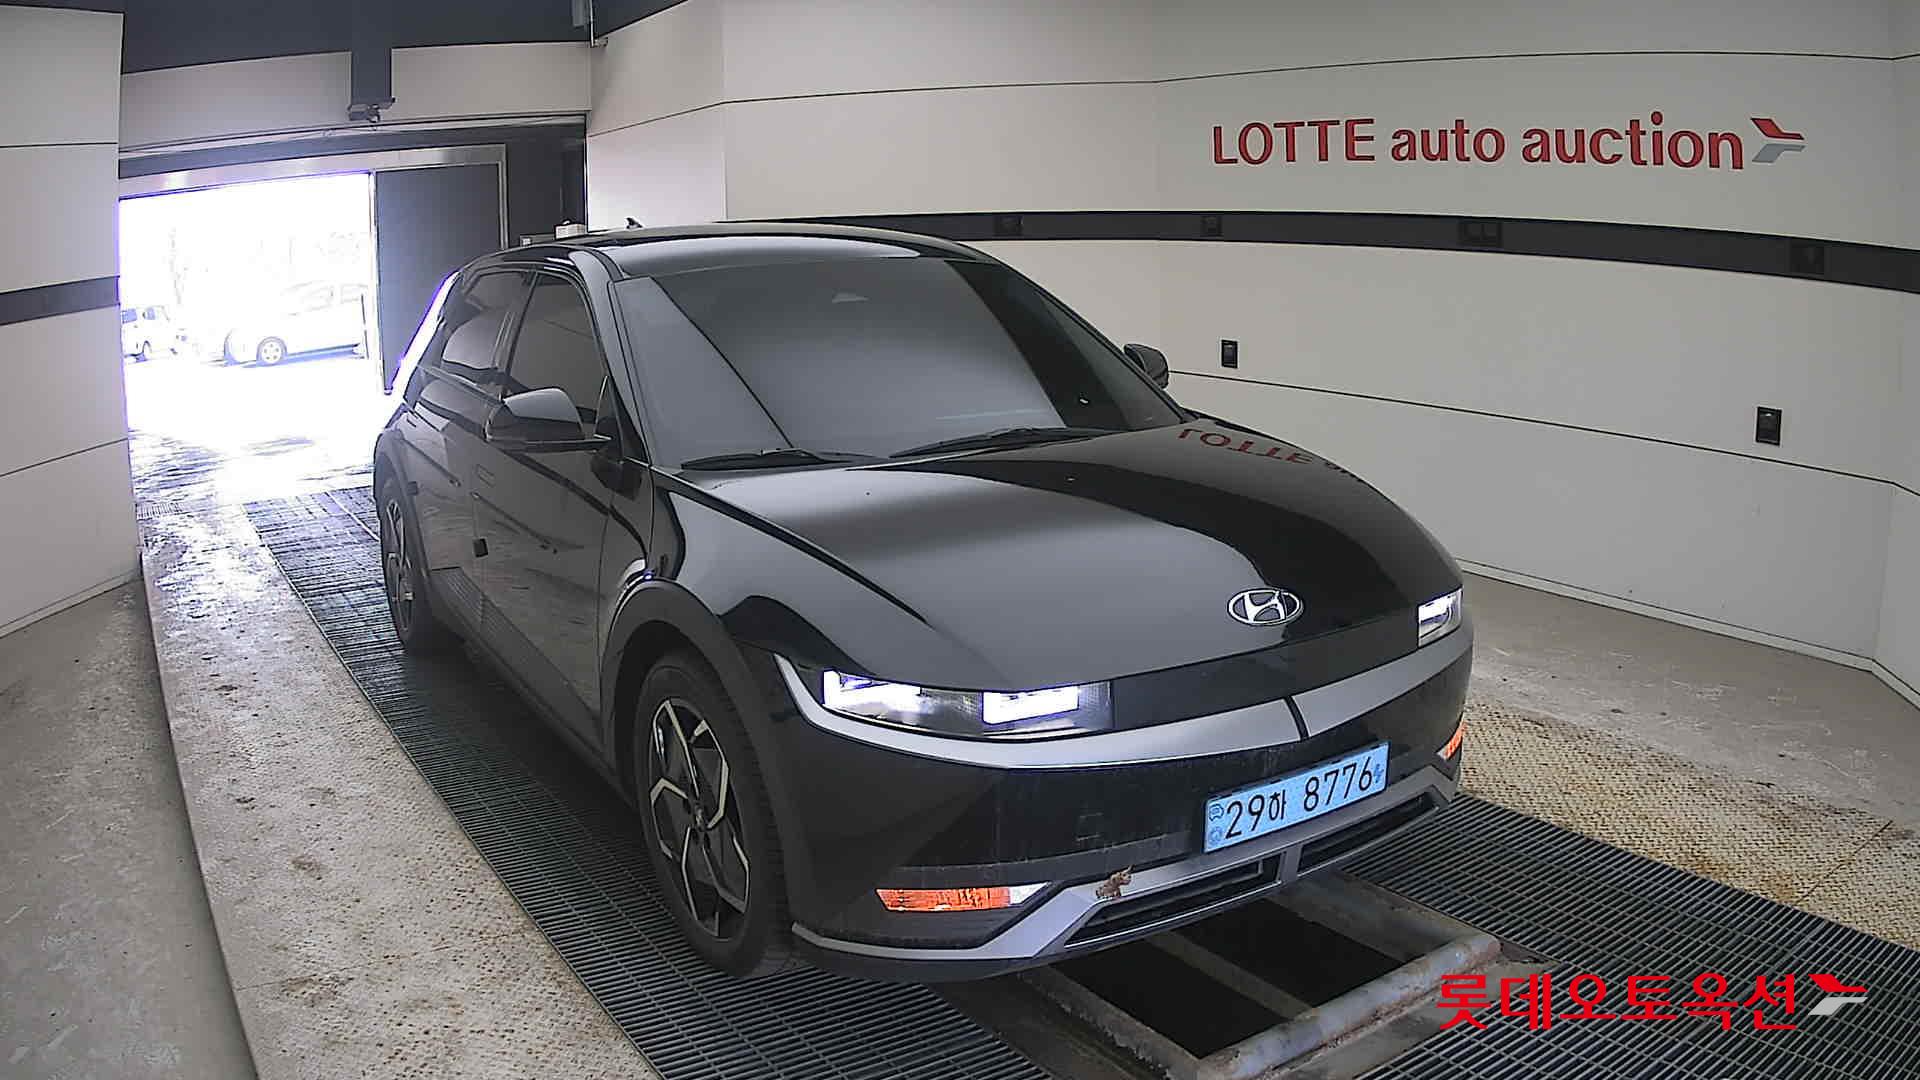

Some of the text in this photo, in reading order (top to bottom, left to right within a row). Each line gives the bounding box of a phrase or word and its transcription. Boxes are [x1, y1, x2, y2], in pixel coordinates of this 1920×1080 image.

[1213, 110, 1744, 170] LOTTE auto auction
[1225, 756, 1373, 840] 29하 8776
